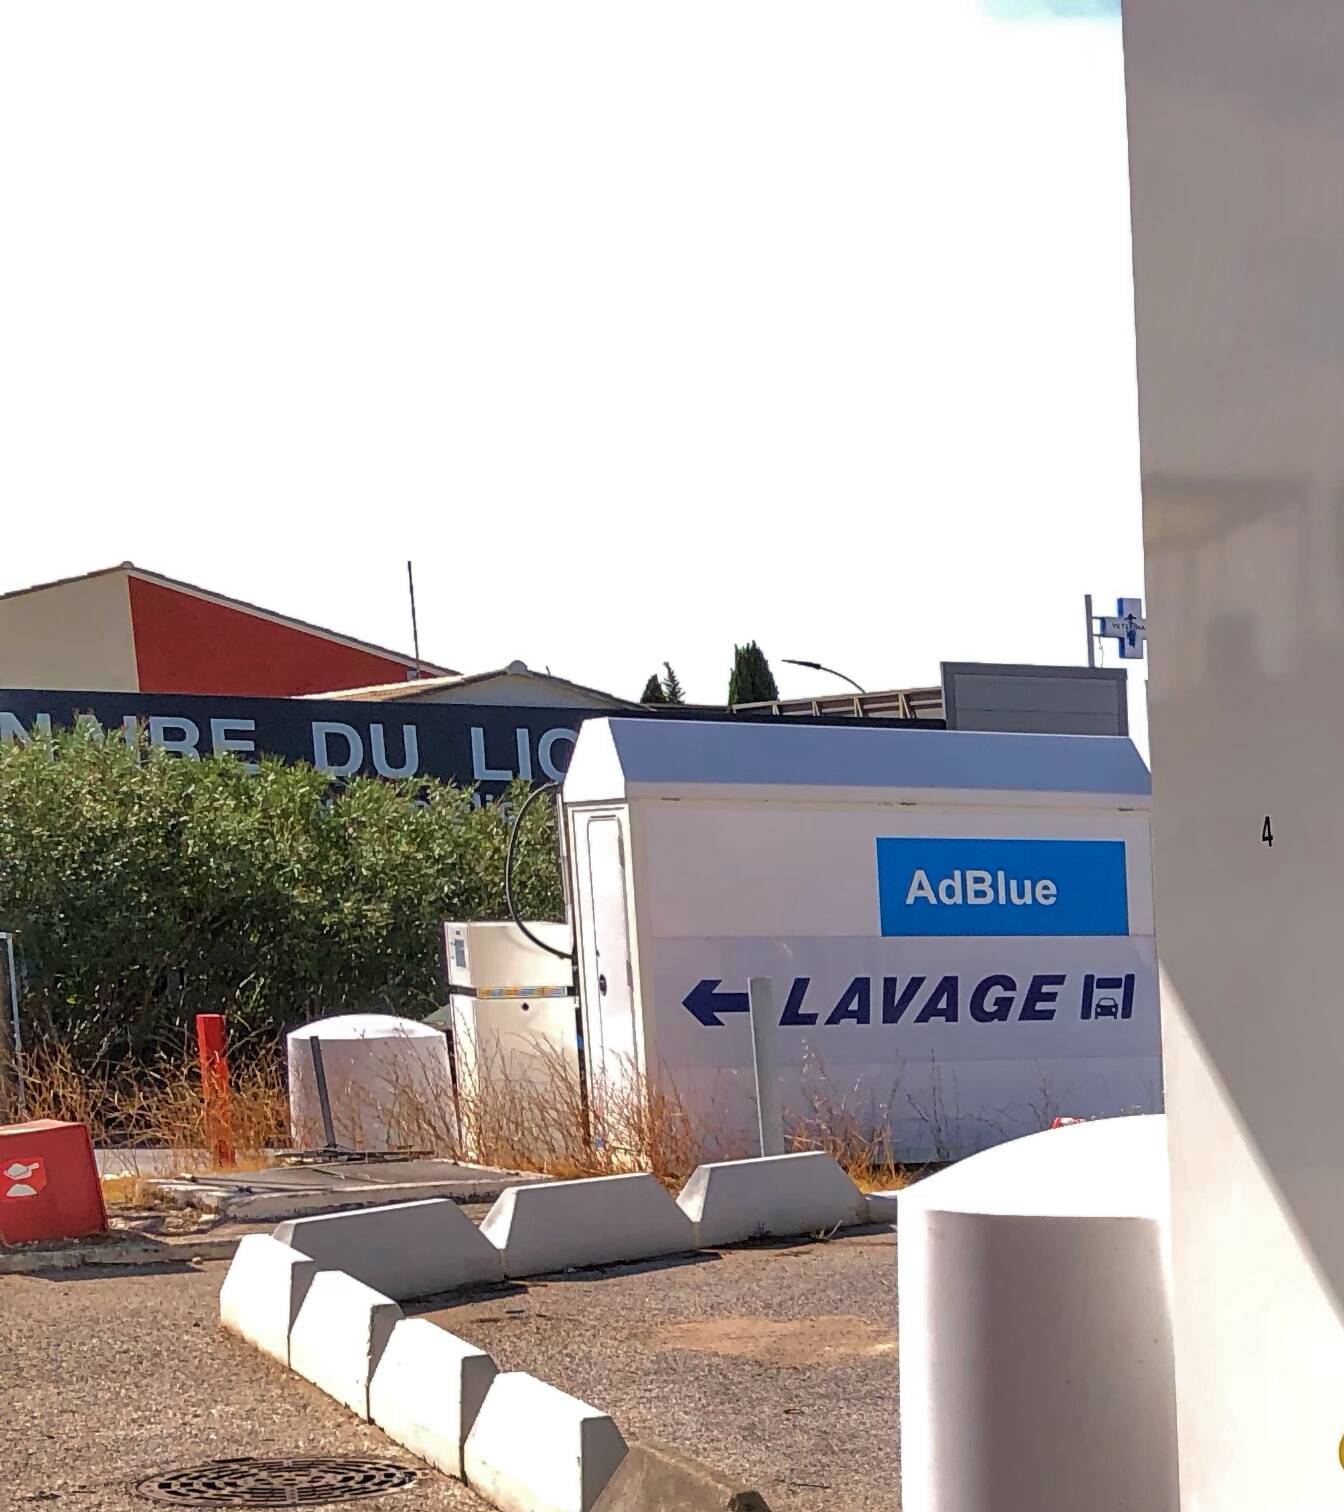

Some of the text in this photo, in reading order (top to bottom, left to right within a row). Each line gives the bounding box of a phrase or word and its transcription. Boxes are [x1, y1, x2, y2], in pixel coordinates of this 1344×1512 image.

[311, 721, 419, 779] DU
[1261, 815, 1274, 848] 4
[905, 868, 1058, 907] AdBlue
[777, 974, 1067, 1027] LAVAGE
